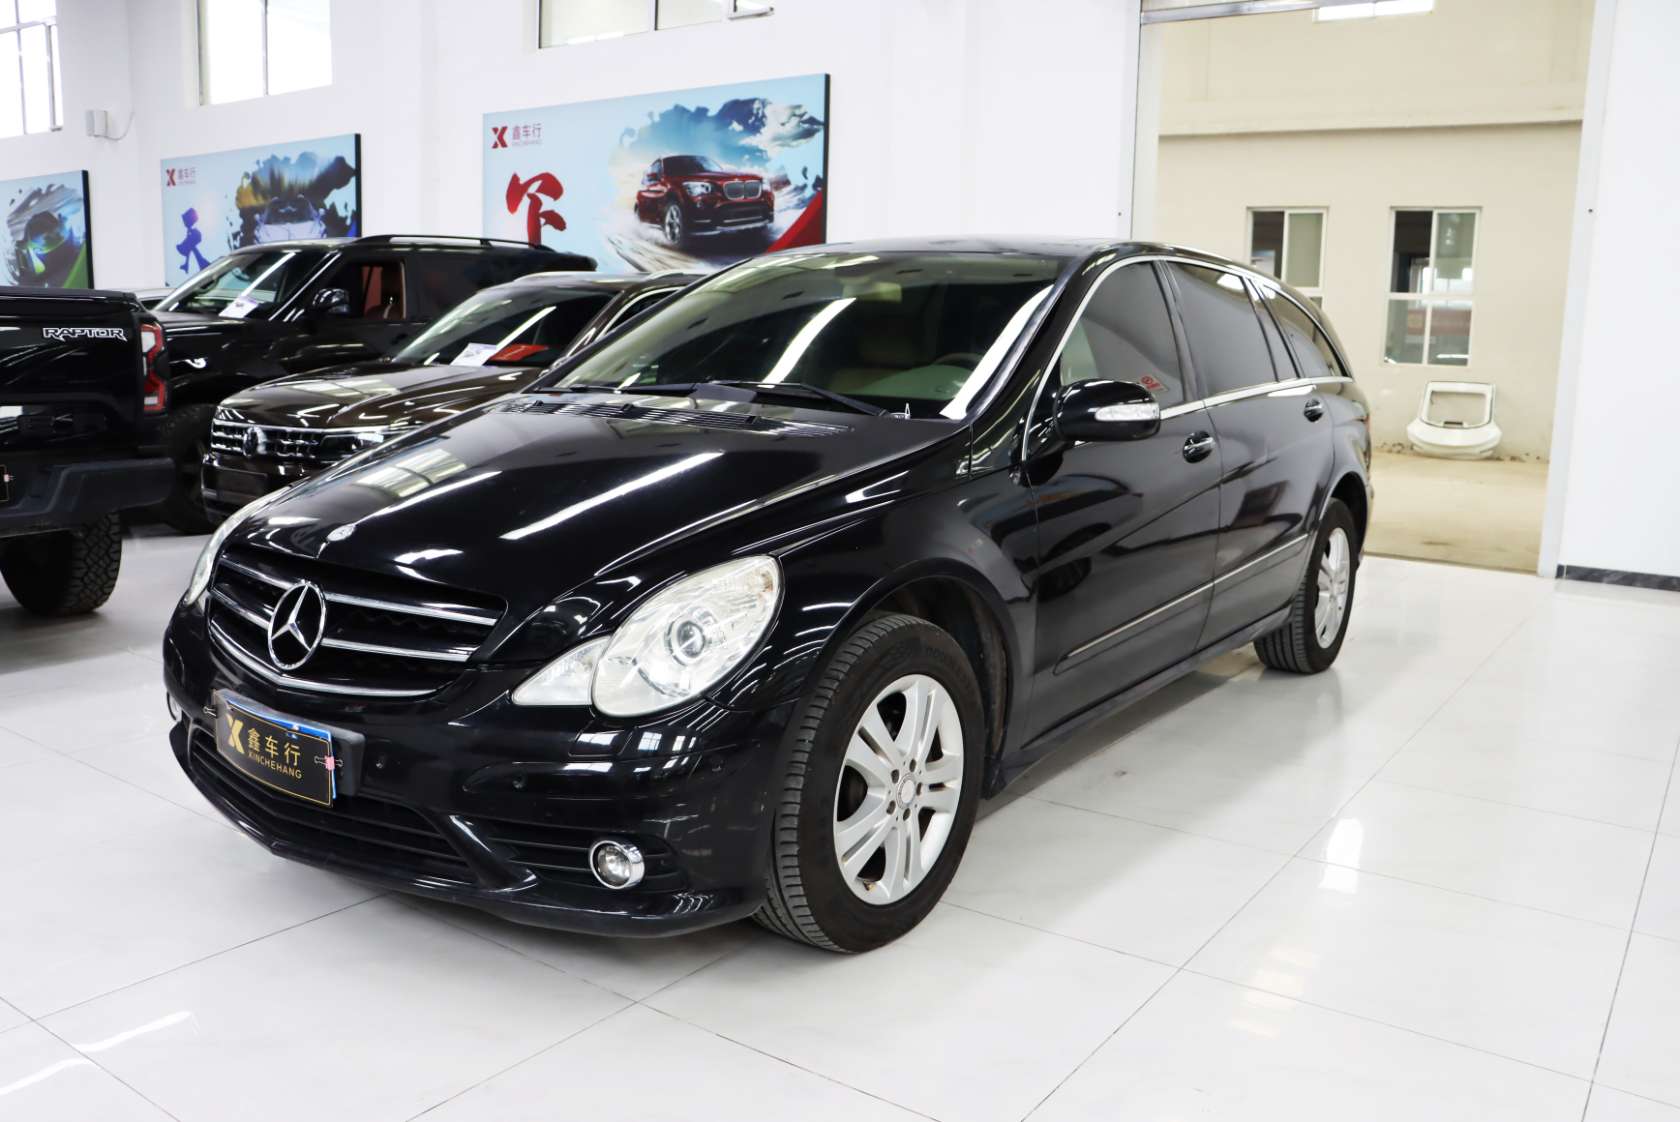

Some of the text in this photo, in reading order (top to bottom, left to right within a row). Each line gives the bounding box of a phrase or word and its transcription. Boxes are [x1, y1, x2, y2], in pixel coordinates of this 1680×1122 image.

[42, 327, 128, 342] RAPTOR
[247, 727, 301, 767] 鑫车行
[248, 751, 302, 779] XINCHEHANG
